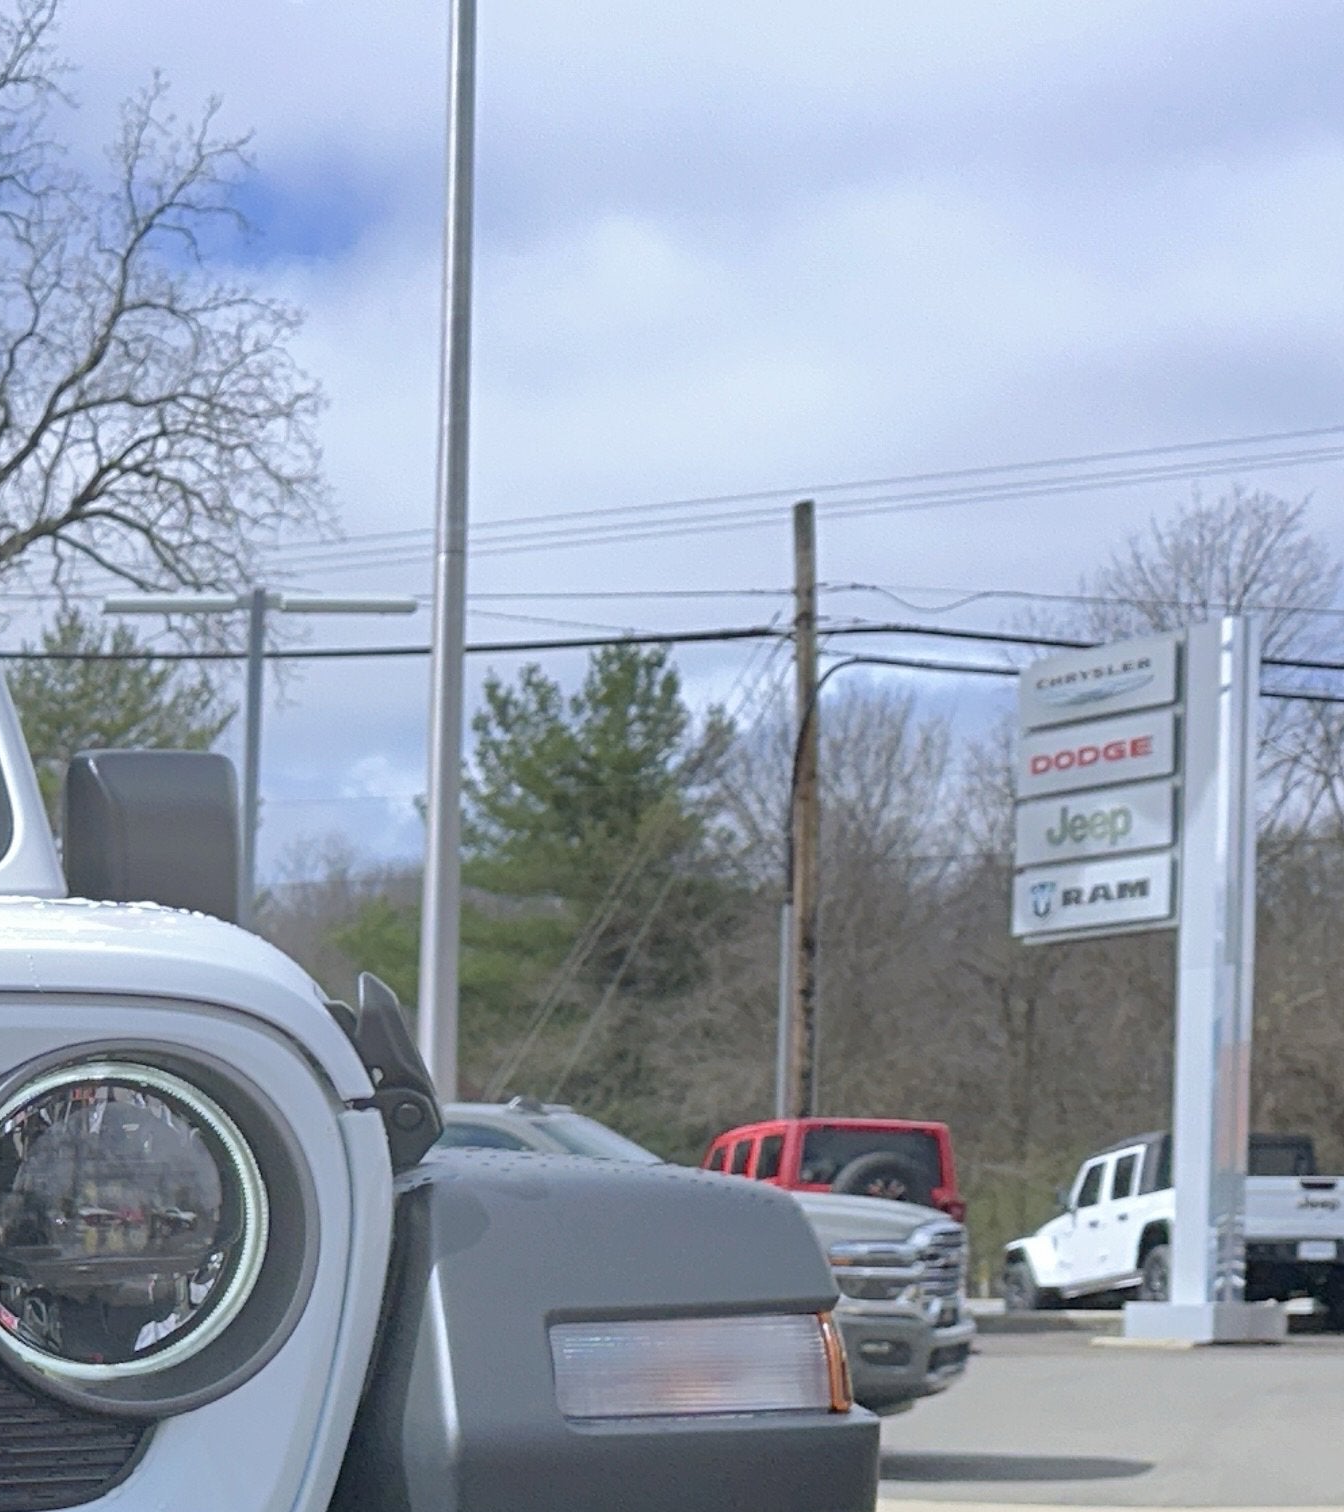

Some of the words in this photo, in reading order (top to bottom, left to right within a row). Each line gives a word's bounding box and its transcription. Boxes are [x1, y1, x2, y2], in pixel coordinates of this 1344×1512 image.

[1035, 656, 1152, 690] CHRYSLER
[1029, 735, 1154, 777] DODGE
[1045, 805, 1133, 848] Jeep
[1062, 878, 1150, 907] RAM
